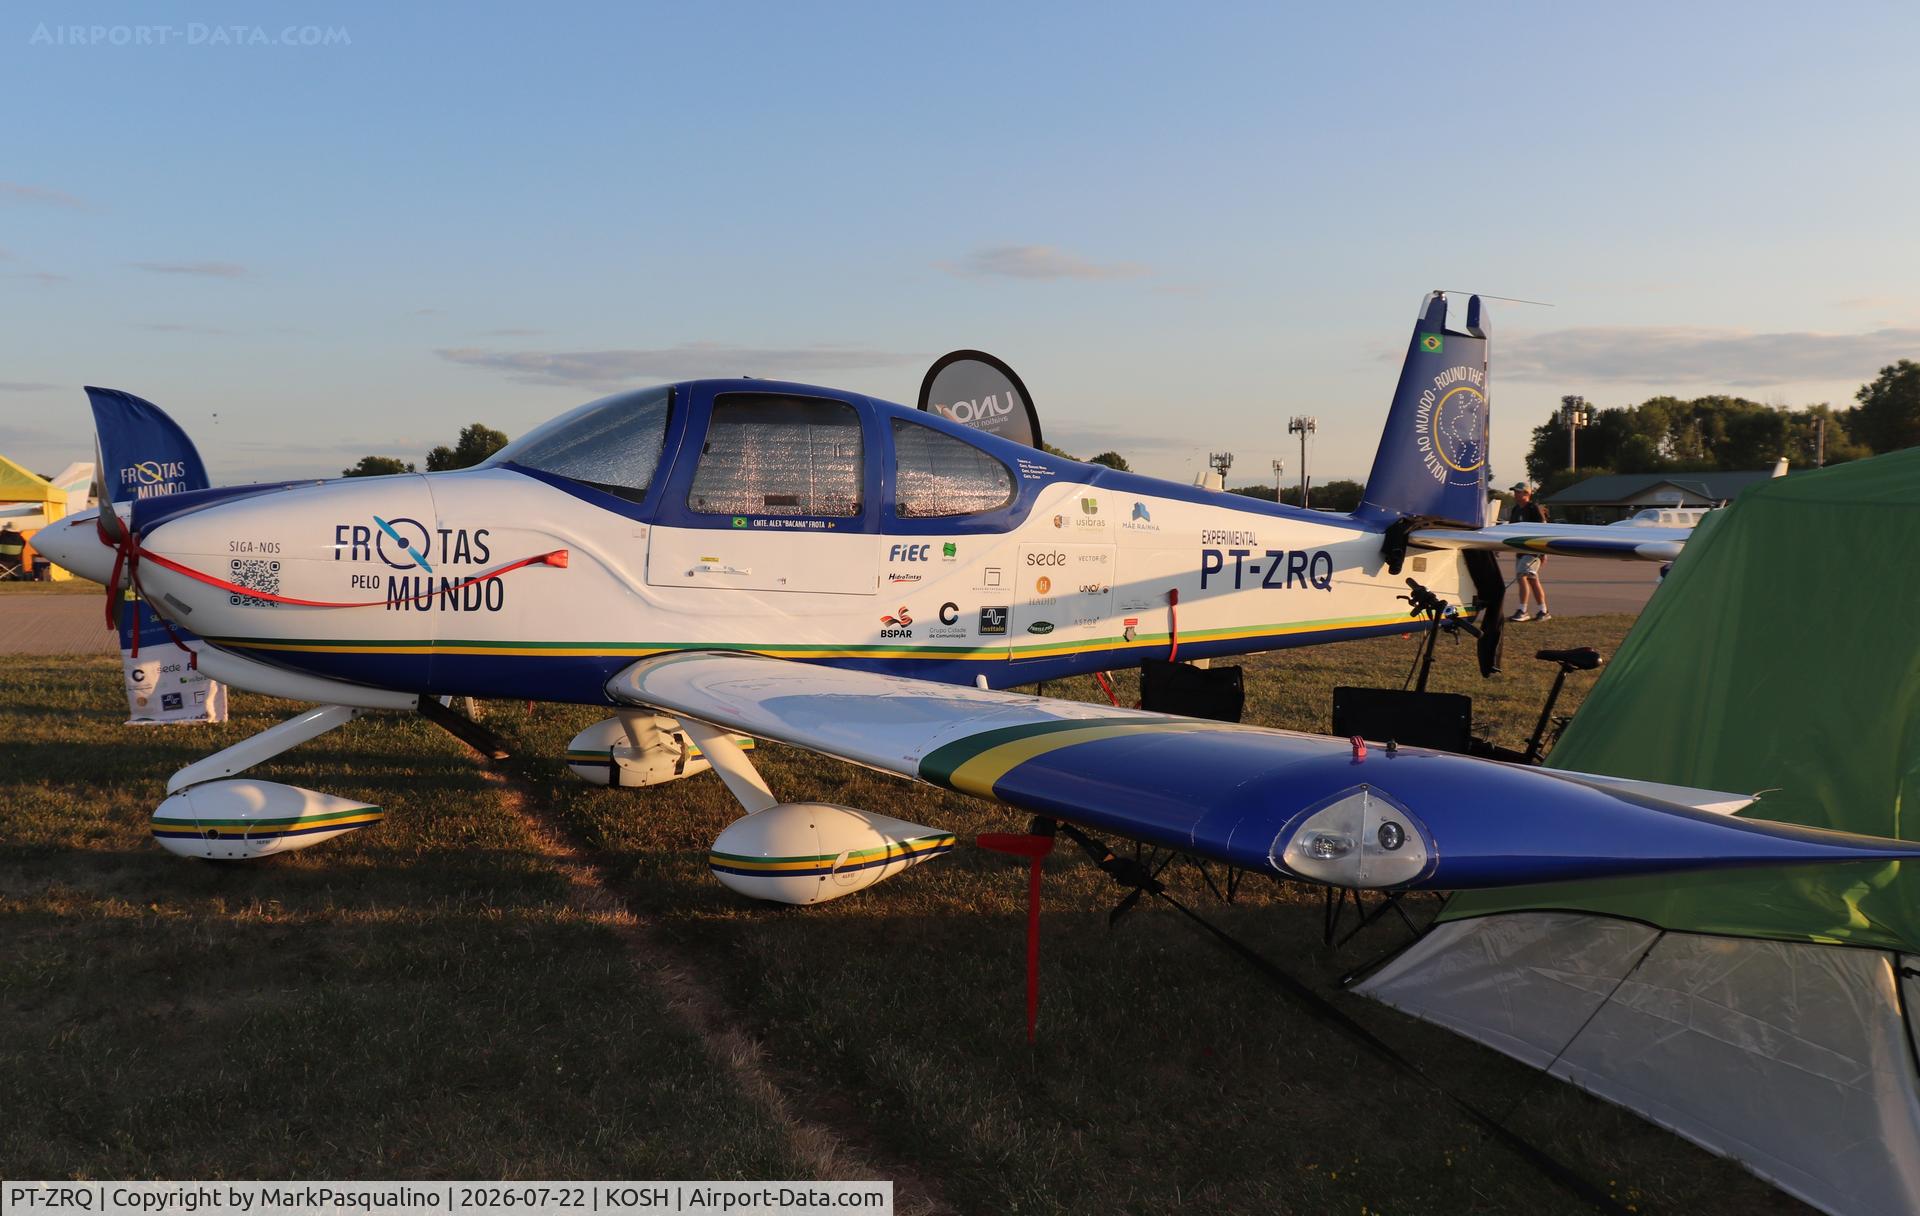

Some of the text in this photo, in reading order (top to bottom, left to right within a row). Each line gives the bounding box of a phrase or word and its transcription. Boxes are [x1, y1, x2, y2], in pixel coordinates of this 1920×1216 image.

[1434, 366, 1467, 390] ROUND
[1468, 367, 1484, 386] THE
[1416, 389, 1436, 434] MUNDO
[1417, 436, 1431, 452] AO
[1423, 452, 1447, 484] VOLTA
[138, 482, 187, 499] MUNDO
[808, 521, 825, 529] FROTA
[1076, 518, 1106, 527] usibras
[1202, 530, 1258, 546] EXPERIMENTAL
[229, 541, 281, 553] SIGA-NOS
[1027, 550, 1067, 567] sede
[1200, 549, 1333, 592] PT-ZRQ
[351, 575, 380, 589] PELO
[386, 576, 504, 612] MUNDO
[881, 630, 912, 638] BSPAR
